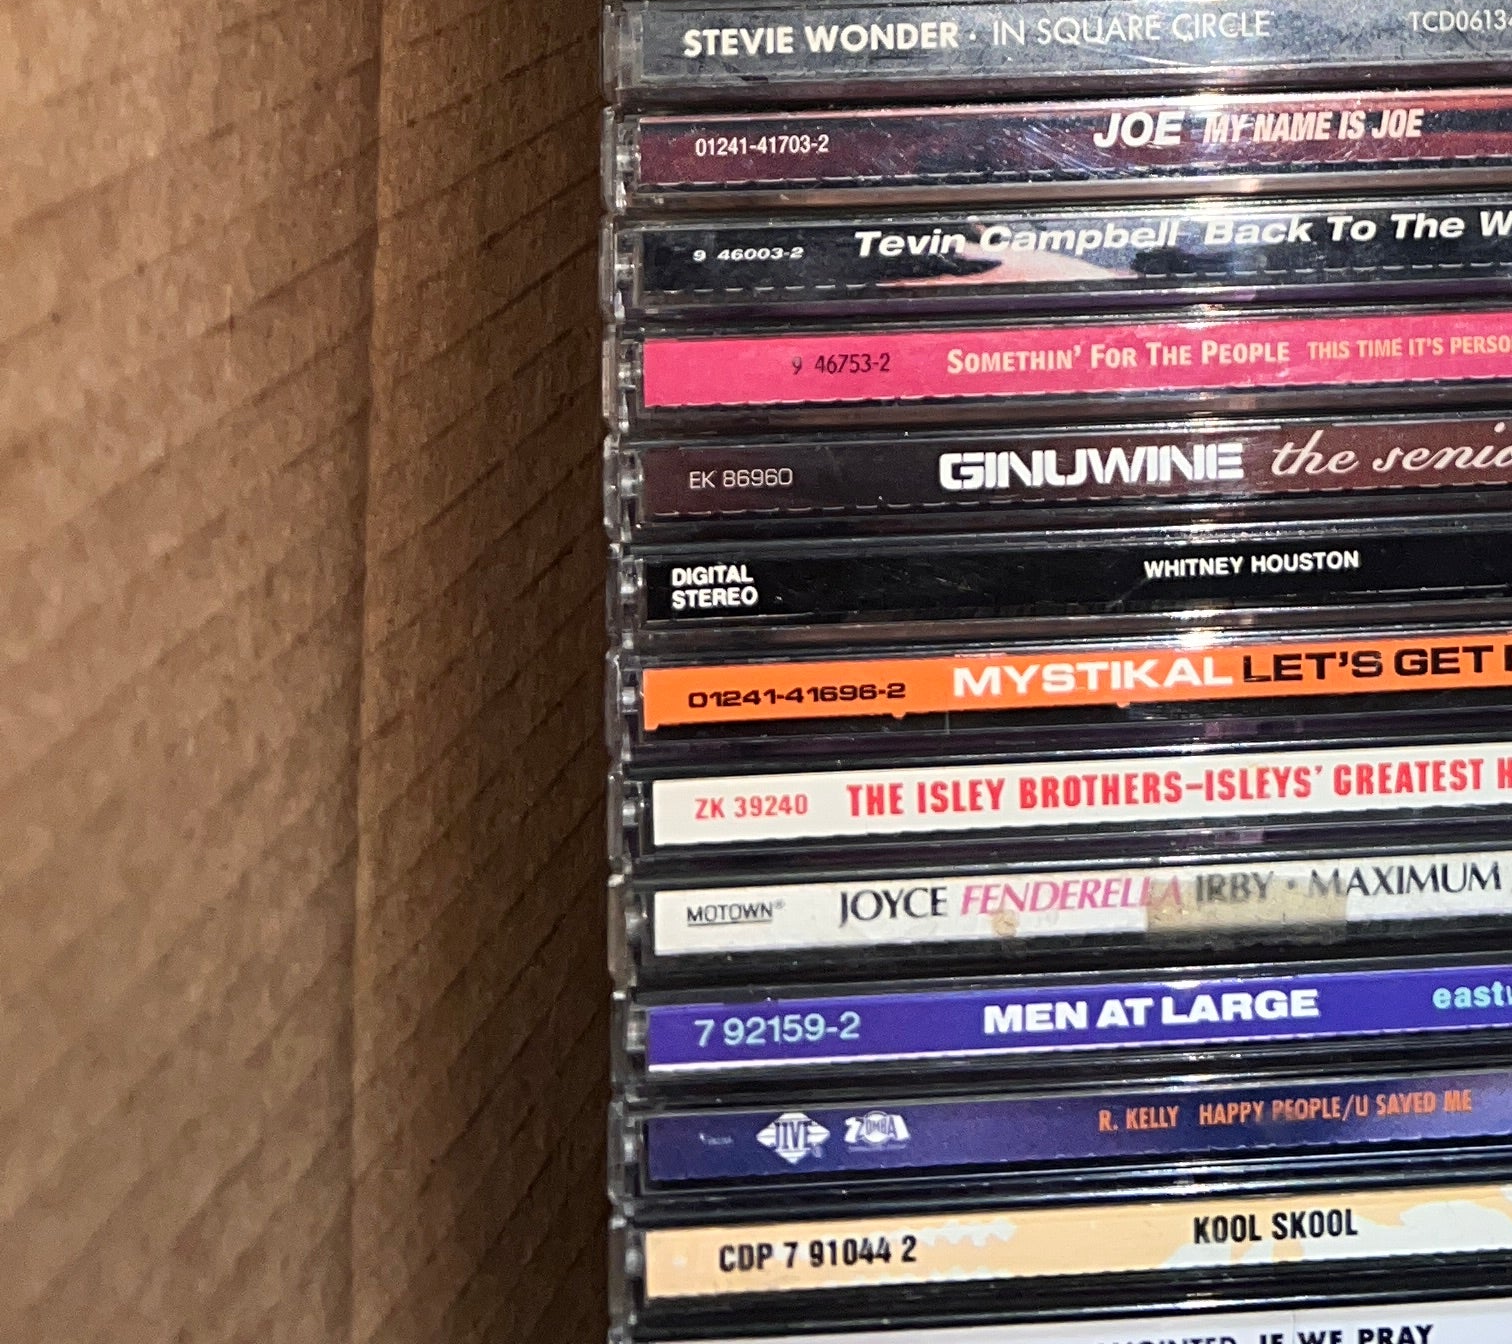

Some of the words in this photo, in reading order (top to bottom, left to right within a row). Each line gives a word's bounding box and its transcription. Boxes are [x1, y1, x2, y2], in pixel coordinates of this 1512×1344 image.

[684, 26, 793, 56] STEVIE
[807, 23, 958, 52] WONDER
[1037, 15, 1160, 44] SQUARE
[1171, 13, 1271, 41] CIRCLE
[1373, 109, 1423, 139] JOE
[695, 135, 829, 157] 01241-41703-2
[717, 246, 804, 261] 46003-2
[855, 230, 966, 257] Tevin
[980, 224, 1178, 254] Campbell
[814, 354, 890, 373] 46753-2
[939, 442, 1245, 490] GINUWINE
[672, 566, 754, 586] DIGITAL
[1145, 557, 1243, 577] WHITNEY
[1251, 551, 1359, 573] HOUSTON
[672, 587, 758, 609] STEREO
[953, 657, 1233, 698] MYSTIKAL
[917, 779, 1003, 814] ISLEY
[1334, 759, 1483, 795] GREATEST
[839, 887, 947, 927] JOYCE
[961, 878, 1182, 916] FENDERELLA
[1308, 860, 1501, 896] MAXIMUM
[984, 1004, 1089, 1034] MEN
[1161, 989, 1319, 1025] LARGE
[1127, 1106, 1178, 1129] KELLY
[1193, 1215, 1262, 1244] KOOL
[1271, 1210, 1358, 1241] SKOOL
[809, 1239, 892, 1268] 91044
[1357, 1324, 1433, 1344] PRAY
